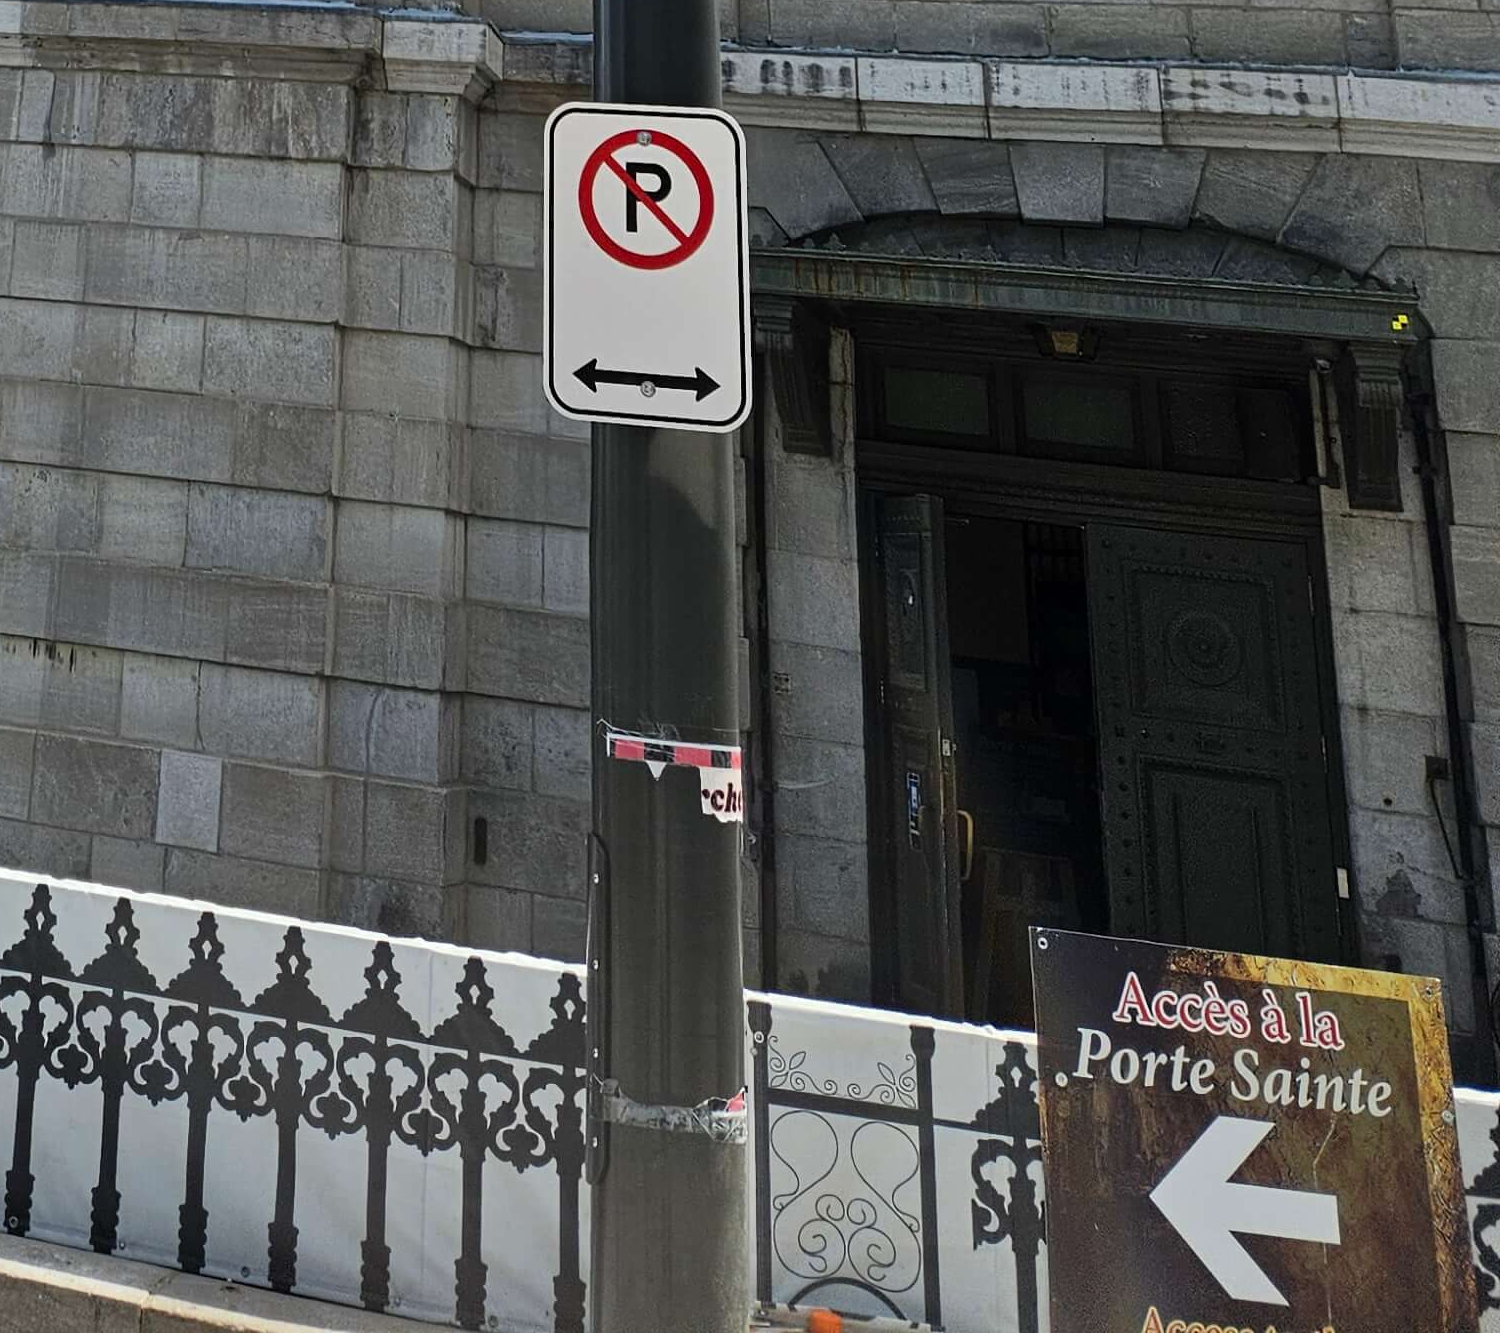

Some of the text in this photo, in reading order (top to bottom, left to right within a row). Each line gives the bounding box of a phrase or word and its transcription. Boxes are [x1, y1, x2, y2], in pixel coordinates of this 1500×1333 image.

[626, 162, 672, 232] P
[702, 783, 743, 812] ch
[1112, 970, 1344, 1051] Accès à la
[1073, 1028, 1392, 1118] Porte Sainte
